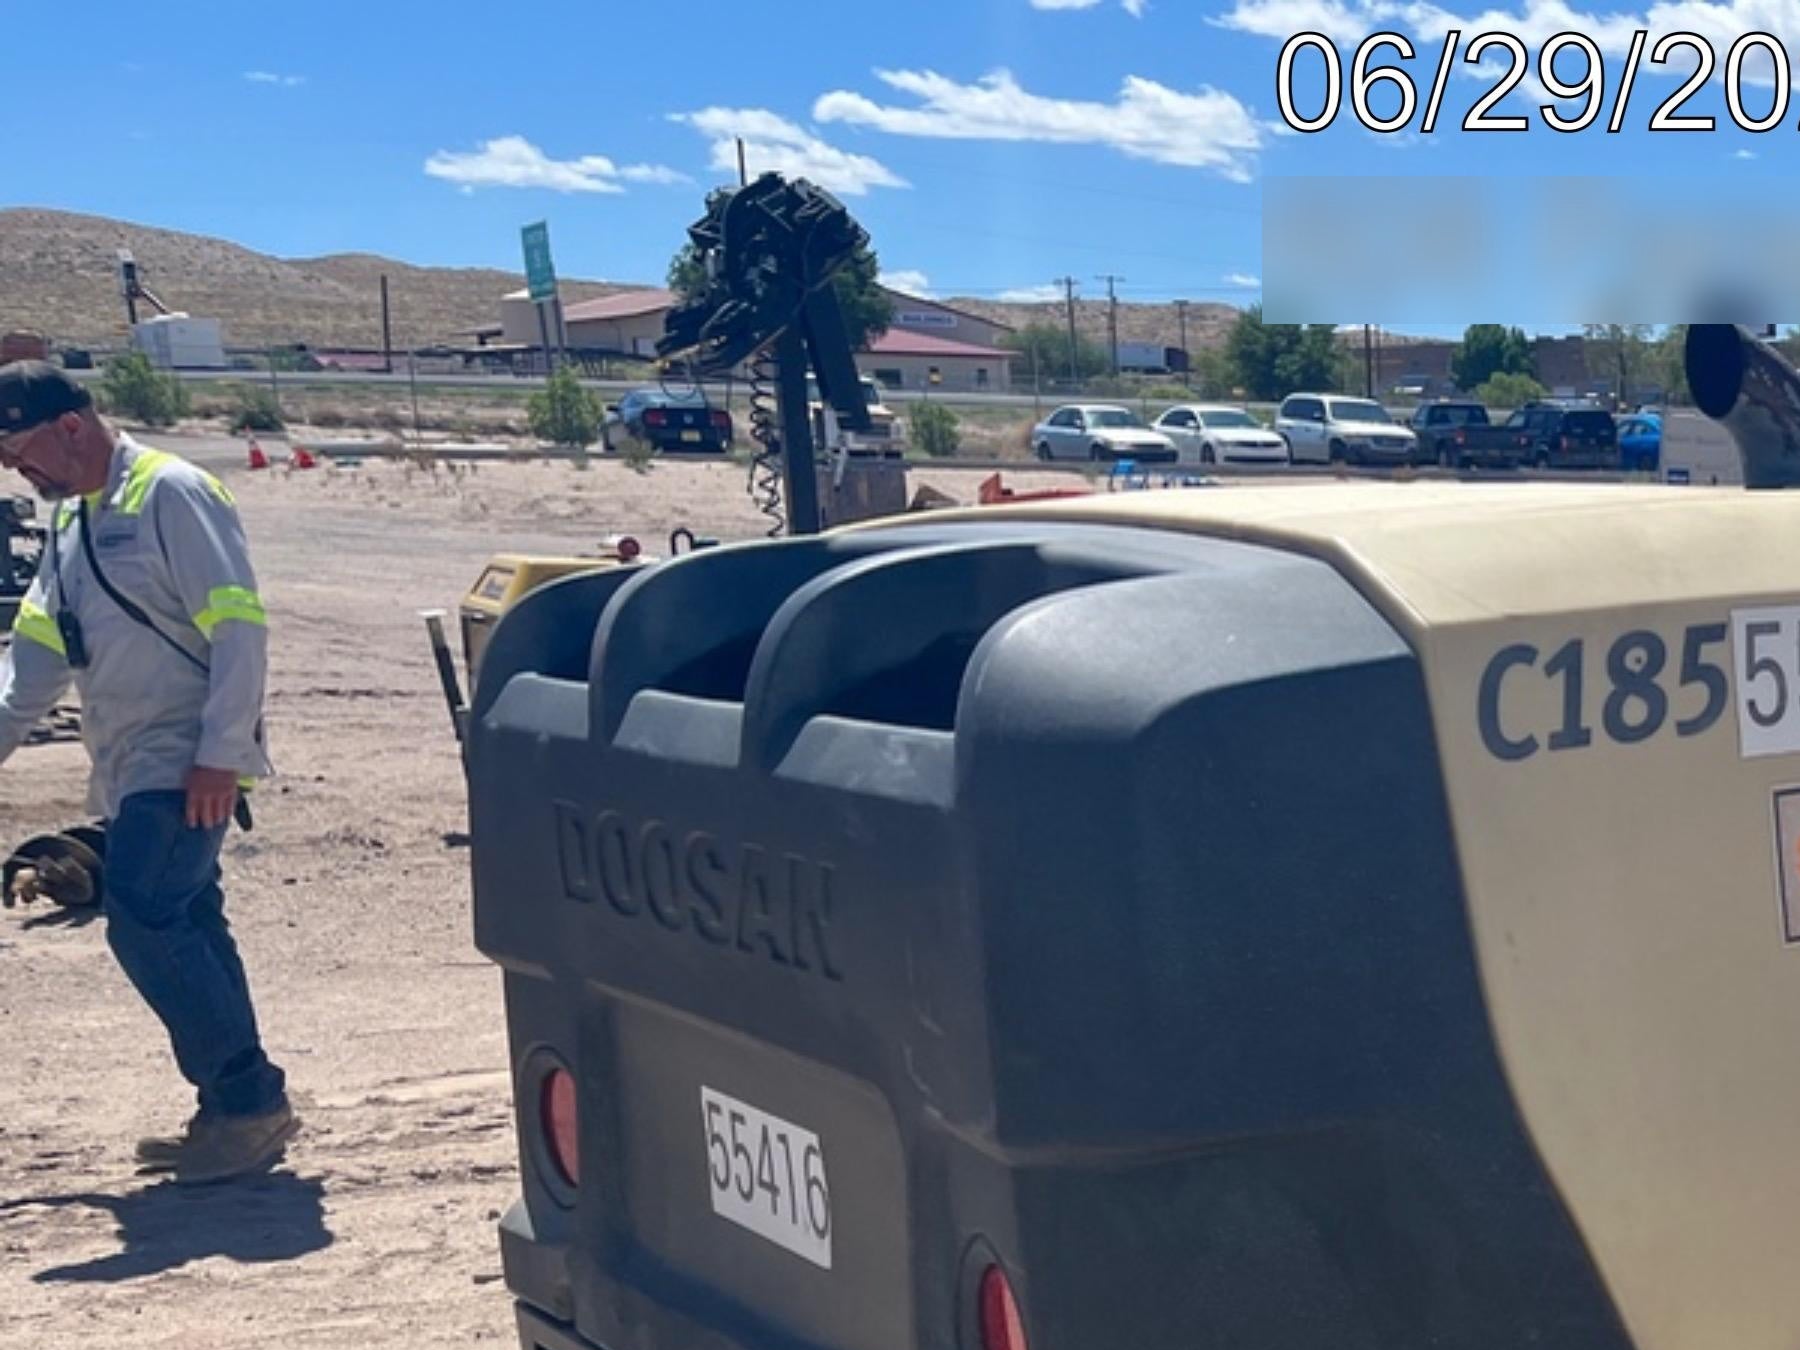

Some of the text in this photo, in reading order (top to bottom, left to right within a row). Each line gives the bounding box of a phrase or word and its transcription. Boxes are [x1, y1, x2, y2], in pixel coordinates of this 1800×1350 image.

[1477, 622, 1729, 762] C185
[553, 799, 844, 981] DOOSAN
[706, 1100, 829, 1240] 55416
